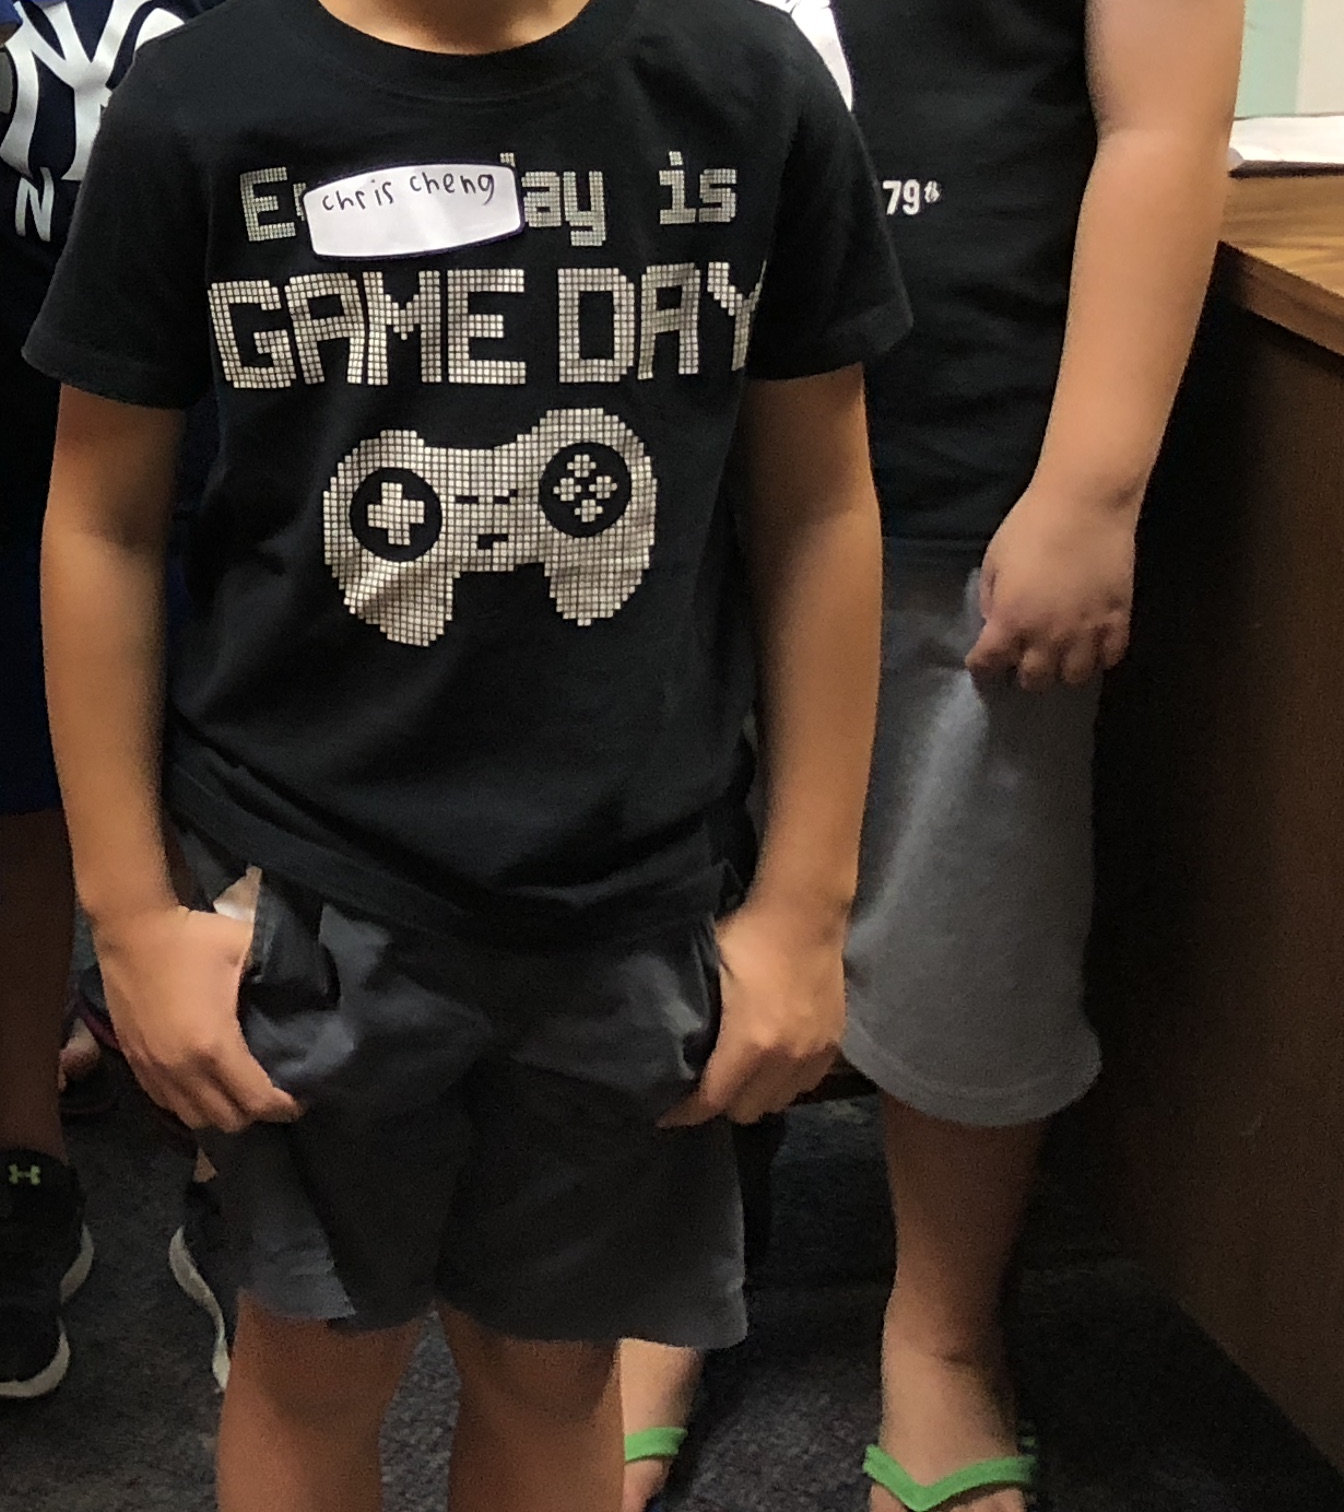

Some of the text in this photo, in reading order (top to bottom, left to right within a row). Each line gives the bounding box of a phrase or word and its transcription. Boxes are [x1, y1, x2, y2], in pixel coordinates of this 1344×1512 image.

[409, 171, 495, 206] cheng
[659, 151, 738, 225] is
[209, 260, 768, 389] GAME DAY
